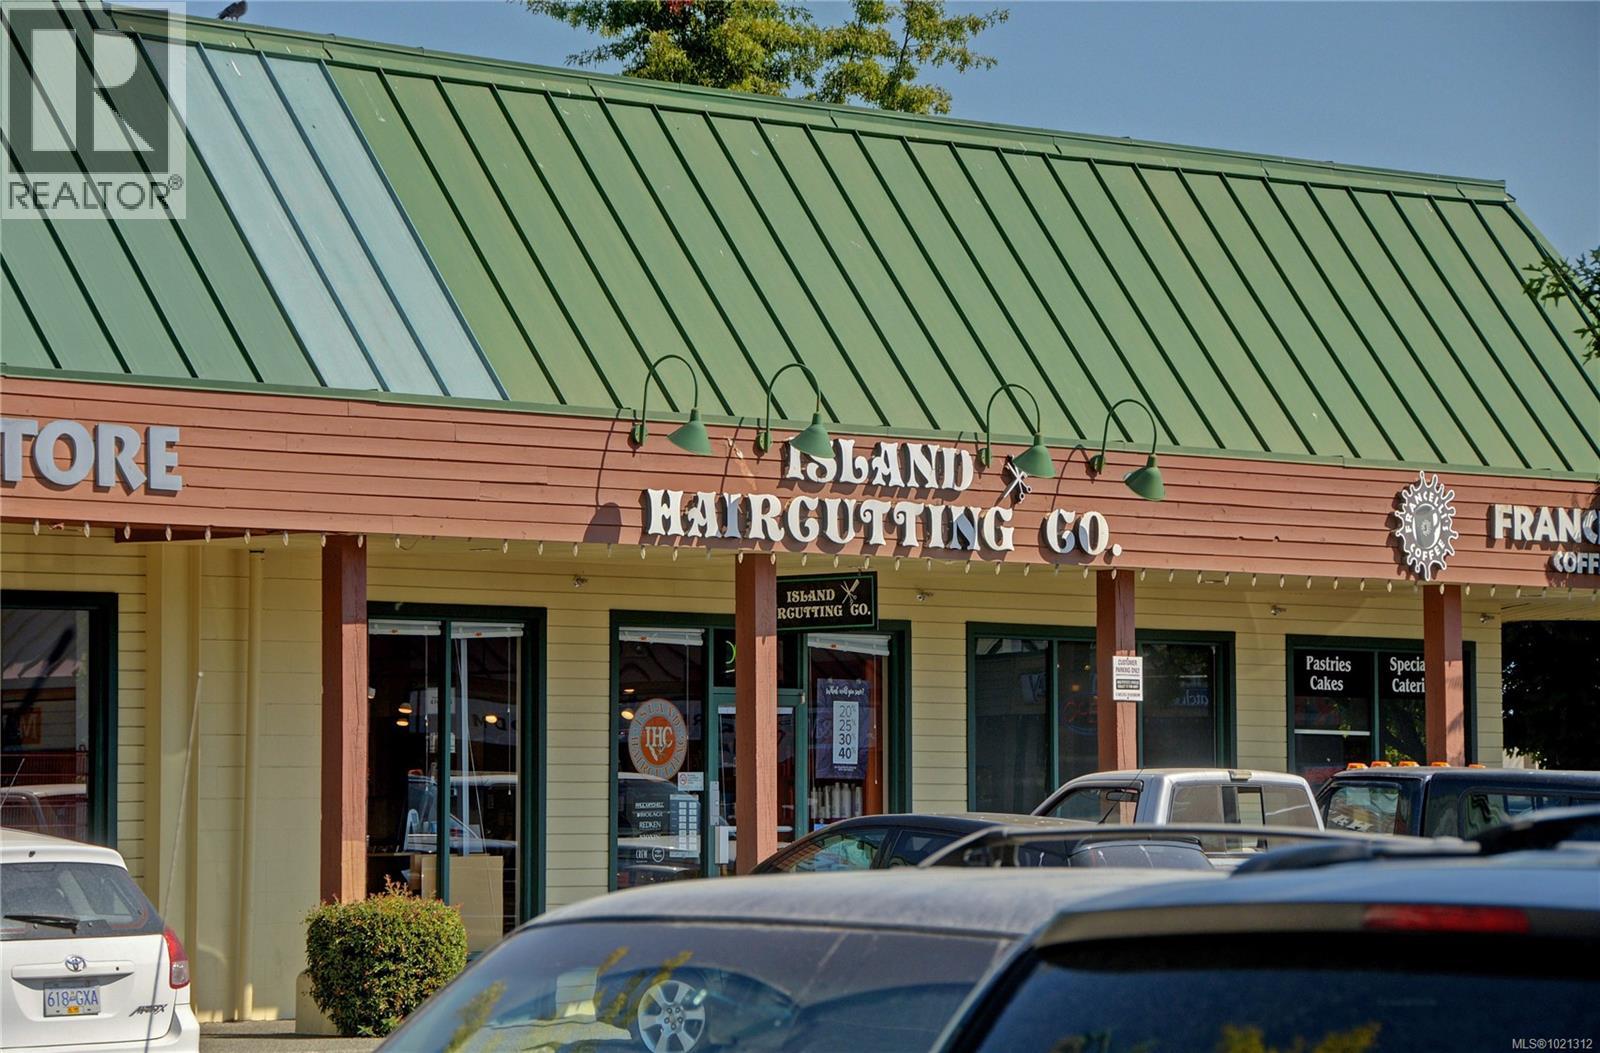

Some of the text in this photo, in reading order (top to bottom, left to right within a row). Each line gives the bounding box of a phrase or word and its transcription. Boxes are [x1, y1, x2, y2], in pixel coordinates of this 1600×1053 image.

[0, 417, 183, 491] TORE
[786, 437, 974, 492] ISLAND
[647, 488, 1122, 557] HAIRCUTTING CO.
[1494, 503, 1600, 545] FRANC
[1410, 539, 1446, 561] COFFEE
[1553, 550, 1600, 574] COFF
[786, 588, 836, 603] ISLAND
[850, 602, 871, 616] CO.
[1306, 655, 1352, 673] Pastries
[1389, 656, 1426, 676] Specia
[1310, 675, 1344, 691] Cakes
[1391, 677, 1426, 693] Cateri
[47, 990, 98, 1007] 618 GXA
